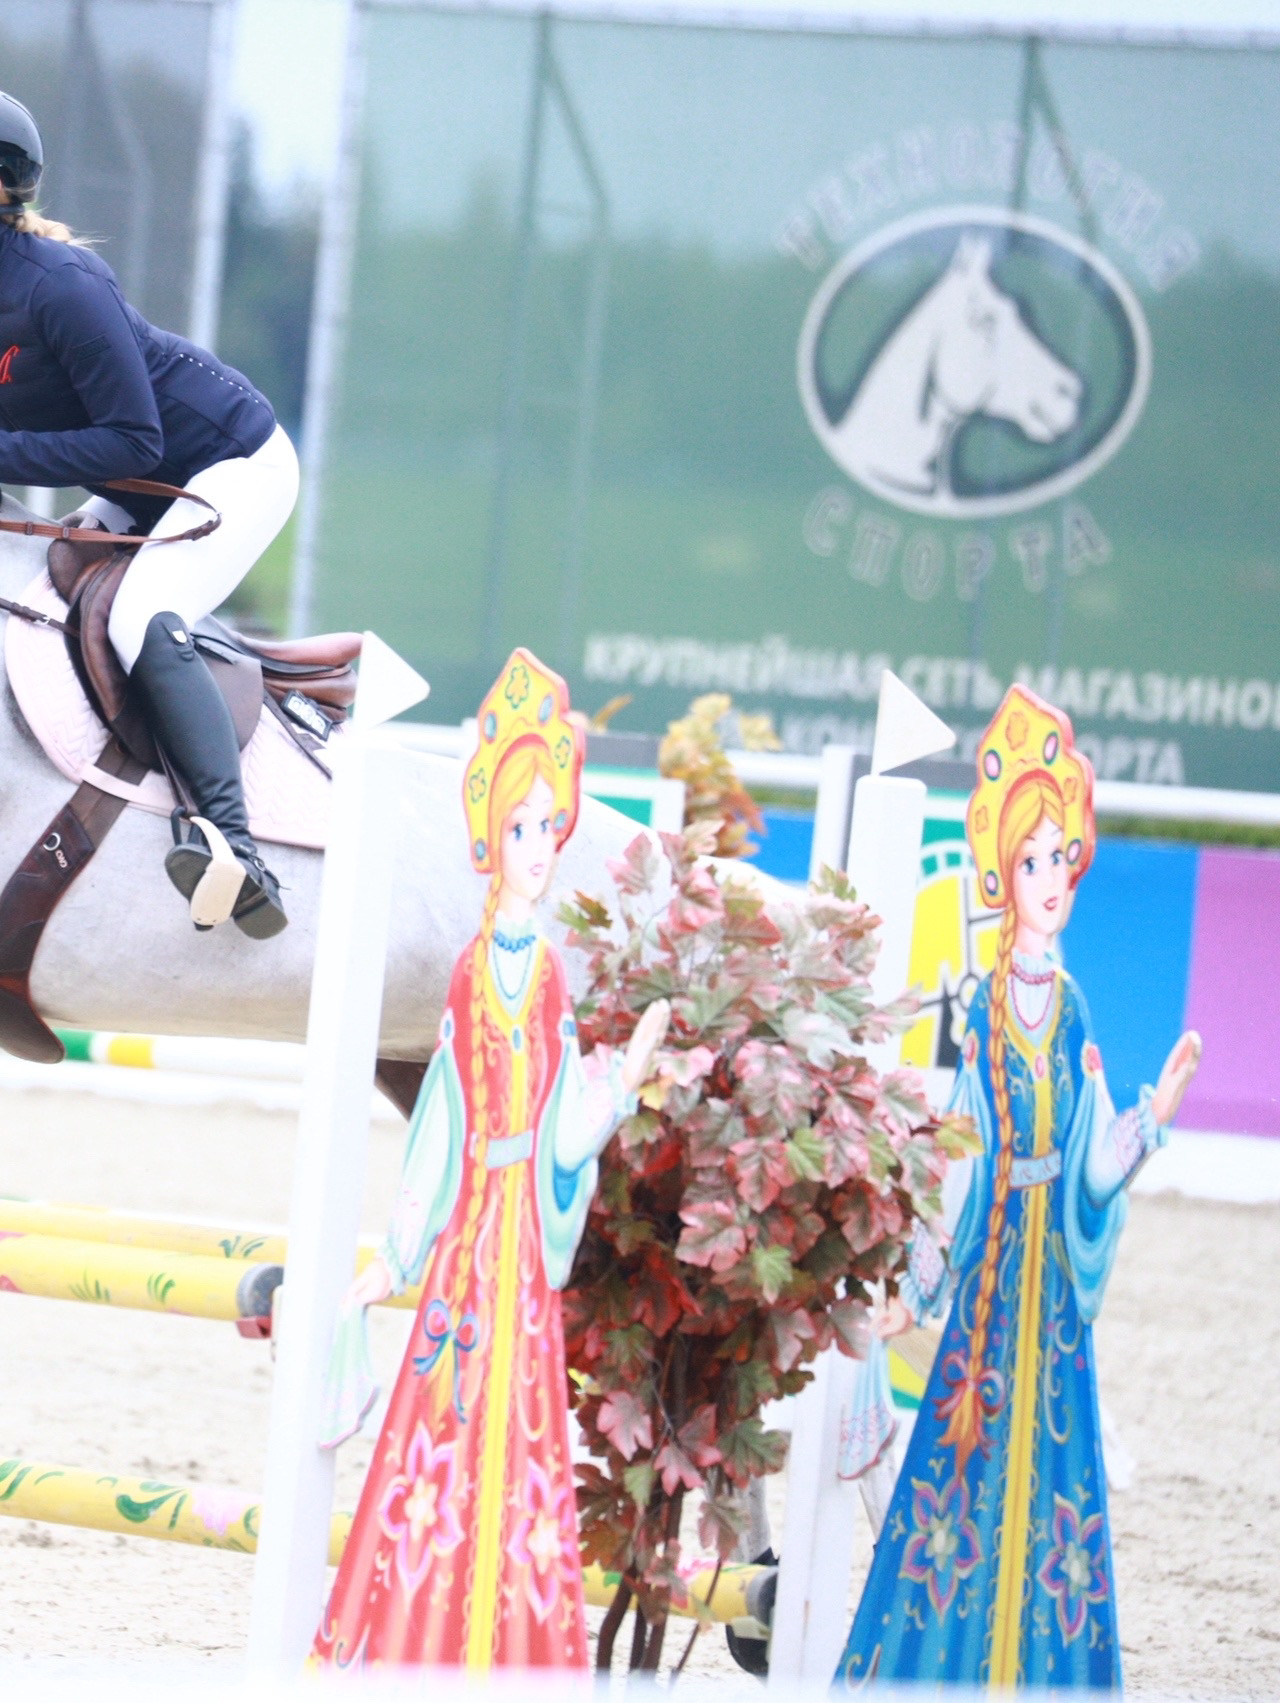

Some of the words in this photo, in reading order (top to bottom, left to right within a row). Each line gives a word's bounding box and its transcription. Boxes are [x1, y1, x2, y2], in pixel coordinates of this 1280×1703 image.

[803, 491, 1111, 601] СПОРТА
[896, 654, 1003, 711] СЕТЬ
[1011, 662, 1280, 732] МАГАЗИНО
